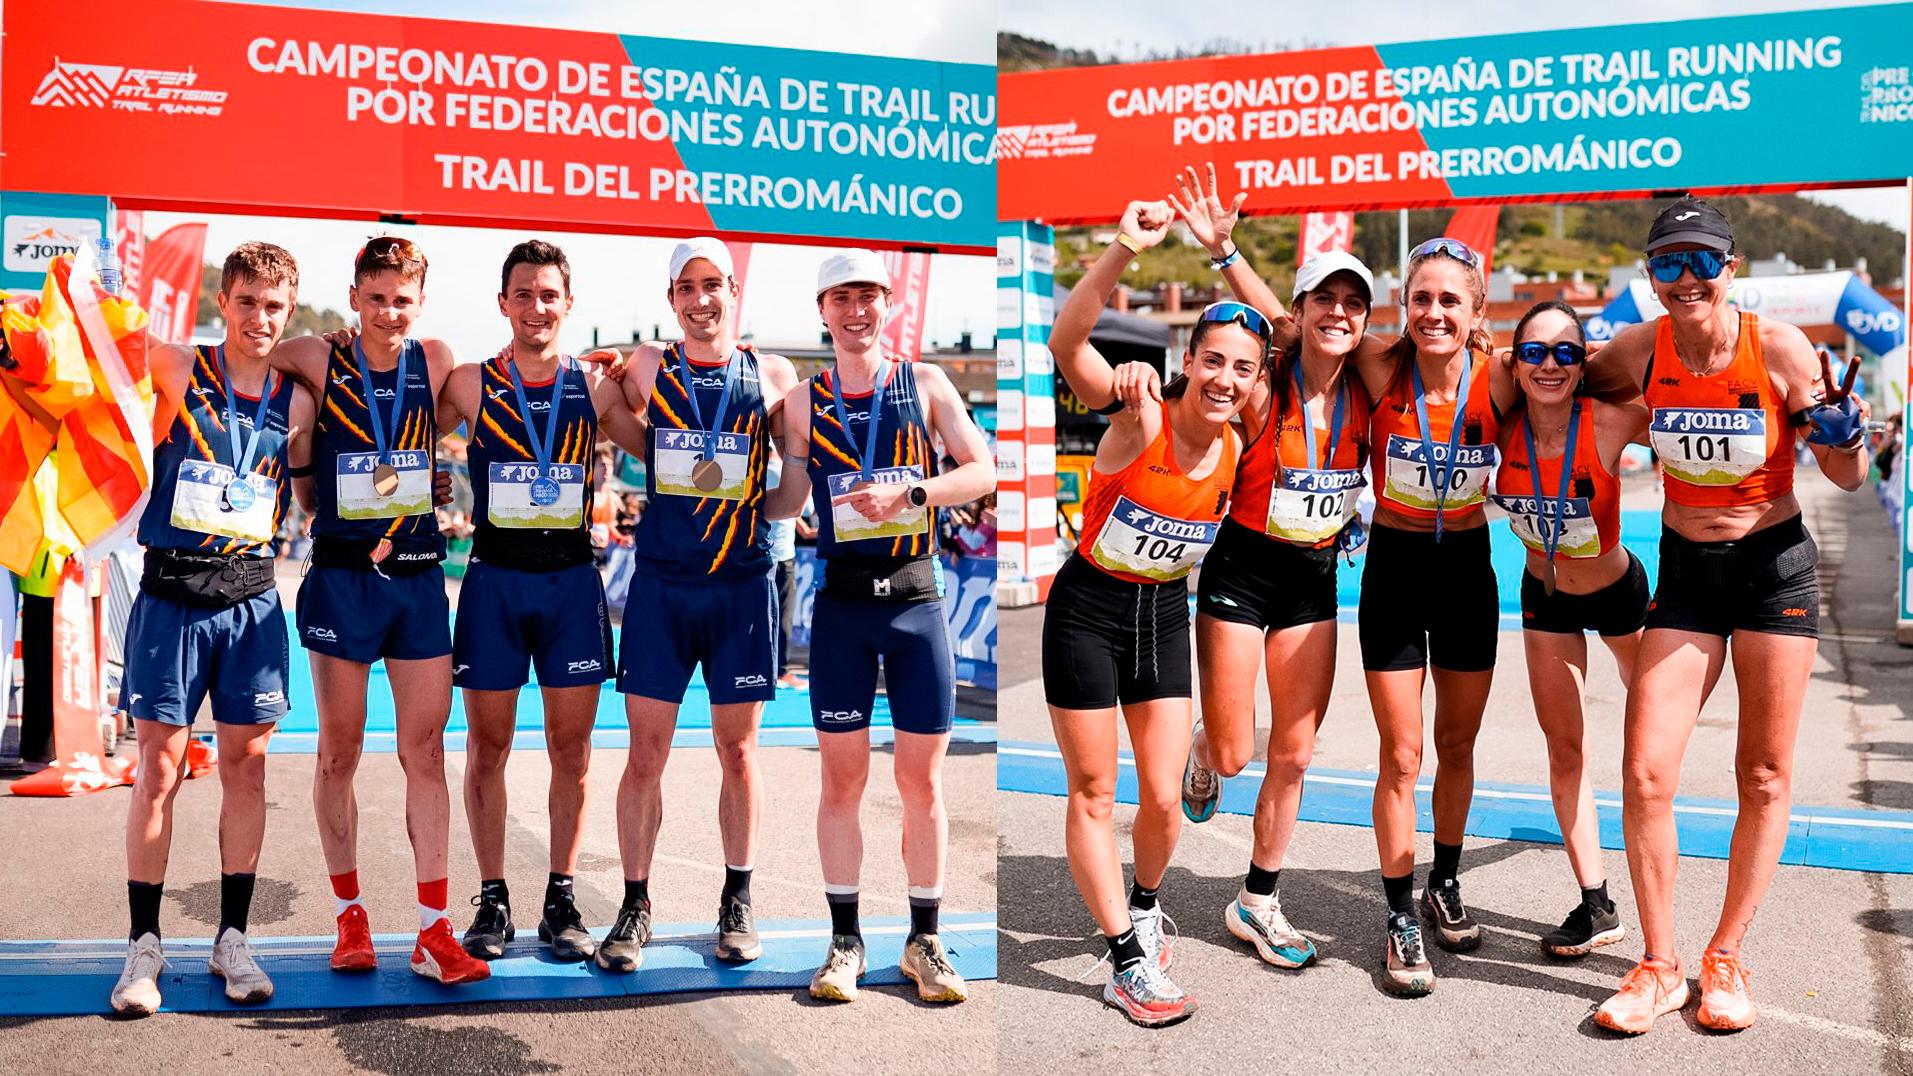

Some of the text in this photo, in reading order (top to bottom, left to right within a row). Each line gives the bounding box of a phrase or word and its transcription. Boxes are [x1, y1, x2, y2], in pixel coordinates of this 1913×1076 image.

[248, 38, 548, 91] CAMPEONATO
[559, 61, 610, 96] DE
[620, 66, 769, 108] ESPAÑA
[781, 79, 828, 112] DE
[837, 83, 938, 121] TRAIL
[1108, 37, 1841, 117] CAMPEONATO DE ESPAÑA DE TRAIL RUNNING
[116, 85, 228, 103] ATLETISMO
[348, 87, 433, 126] POR
[446, 92, 742, 146] FEDERACIONES
[1174, 79, 1751, 145] POR FEDERACIONES AUTONÓMICAS
[1872, 104, 1913, 122] NIC
[1235, 136, 1682, 188] TRAIL DEL PRERROMÁNICO
[435, 154, 962, 219] TRAIL DEL PRERROMÁNICO
[1680, 412, 1750, 431] Joma
[1678, 435, 1731, 462] 101
[364, 453, 420, 472] Jma
[1416, 465, 1468, 491] 100
[1302, 492, 1344, 518] 102
[1144, 516, 1206, 540] Joma
[1133, 534, 1188, 563] 104
[307, 626, 337, 639] FCA
[568, 659, 600, 671] FCA
[735, 674, 767, 686] FCA
[821, 709, 863, 720] FCA
